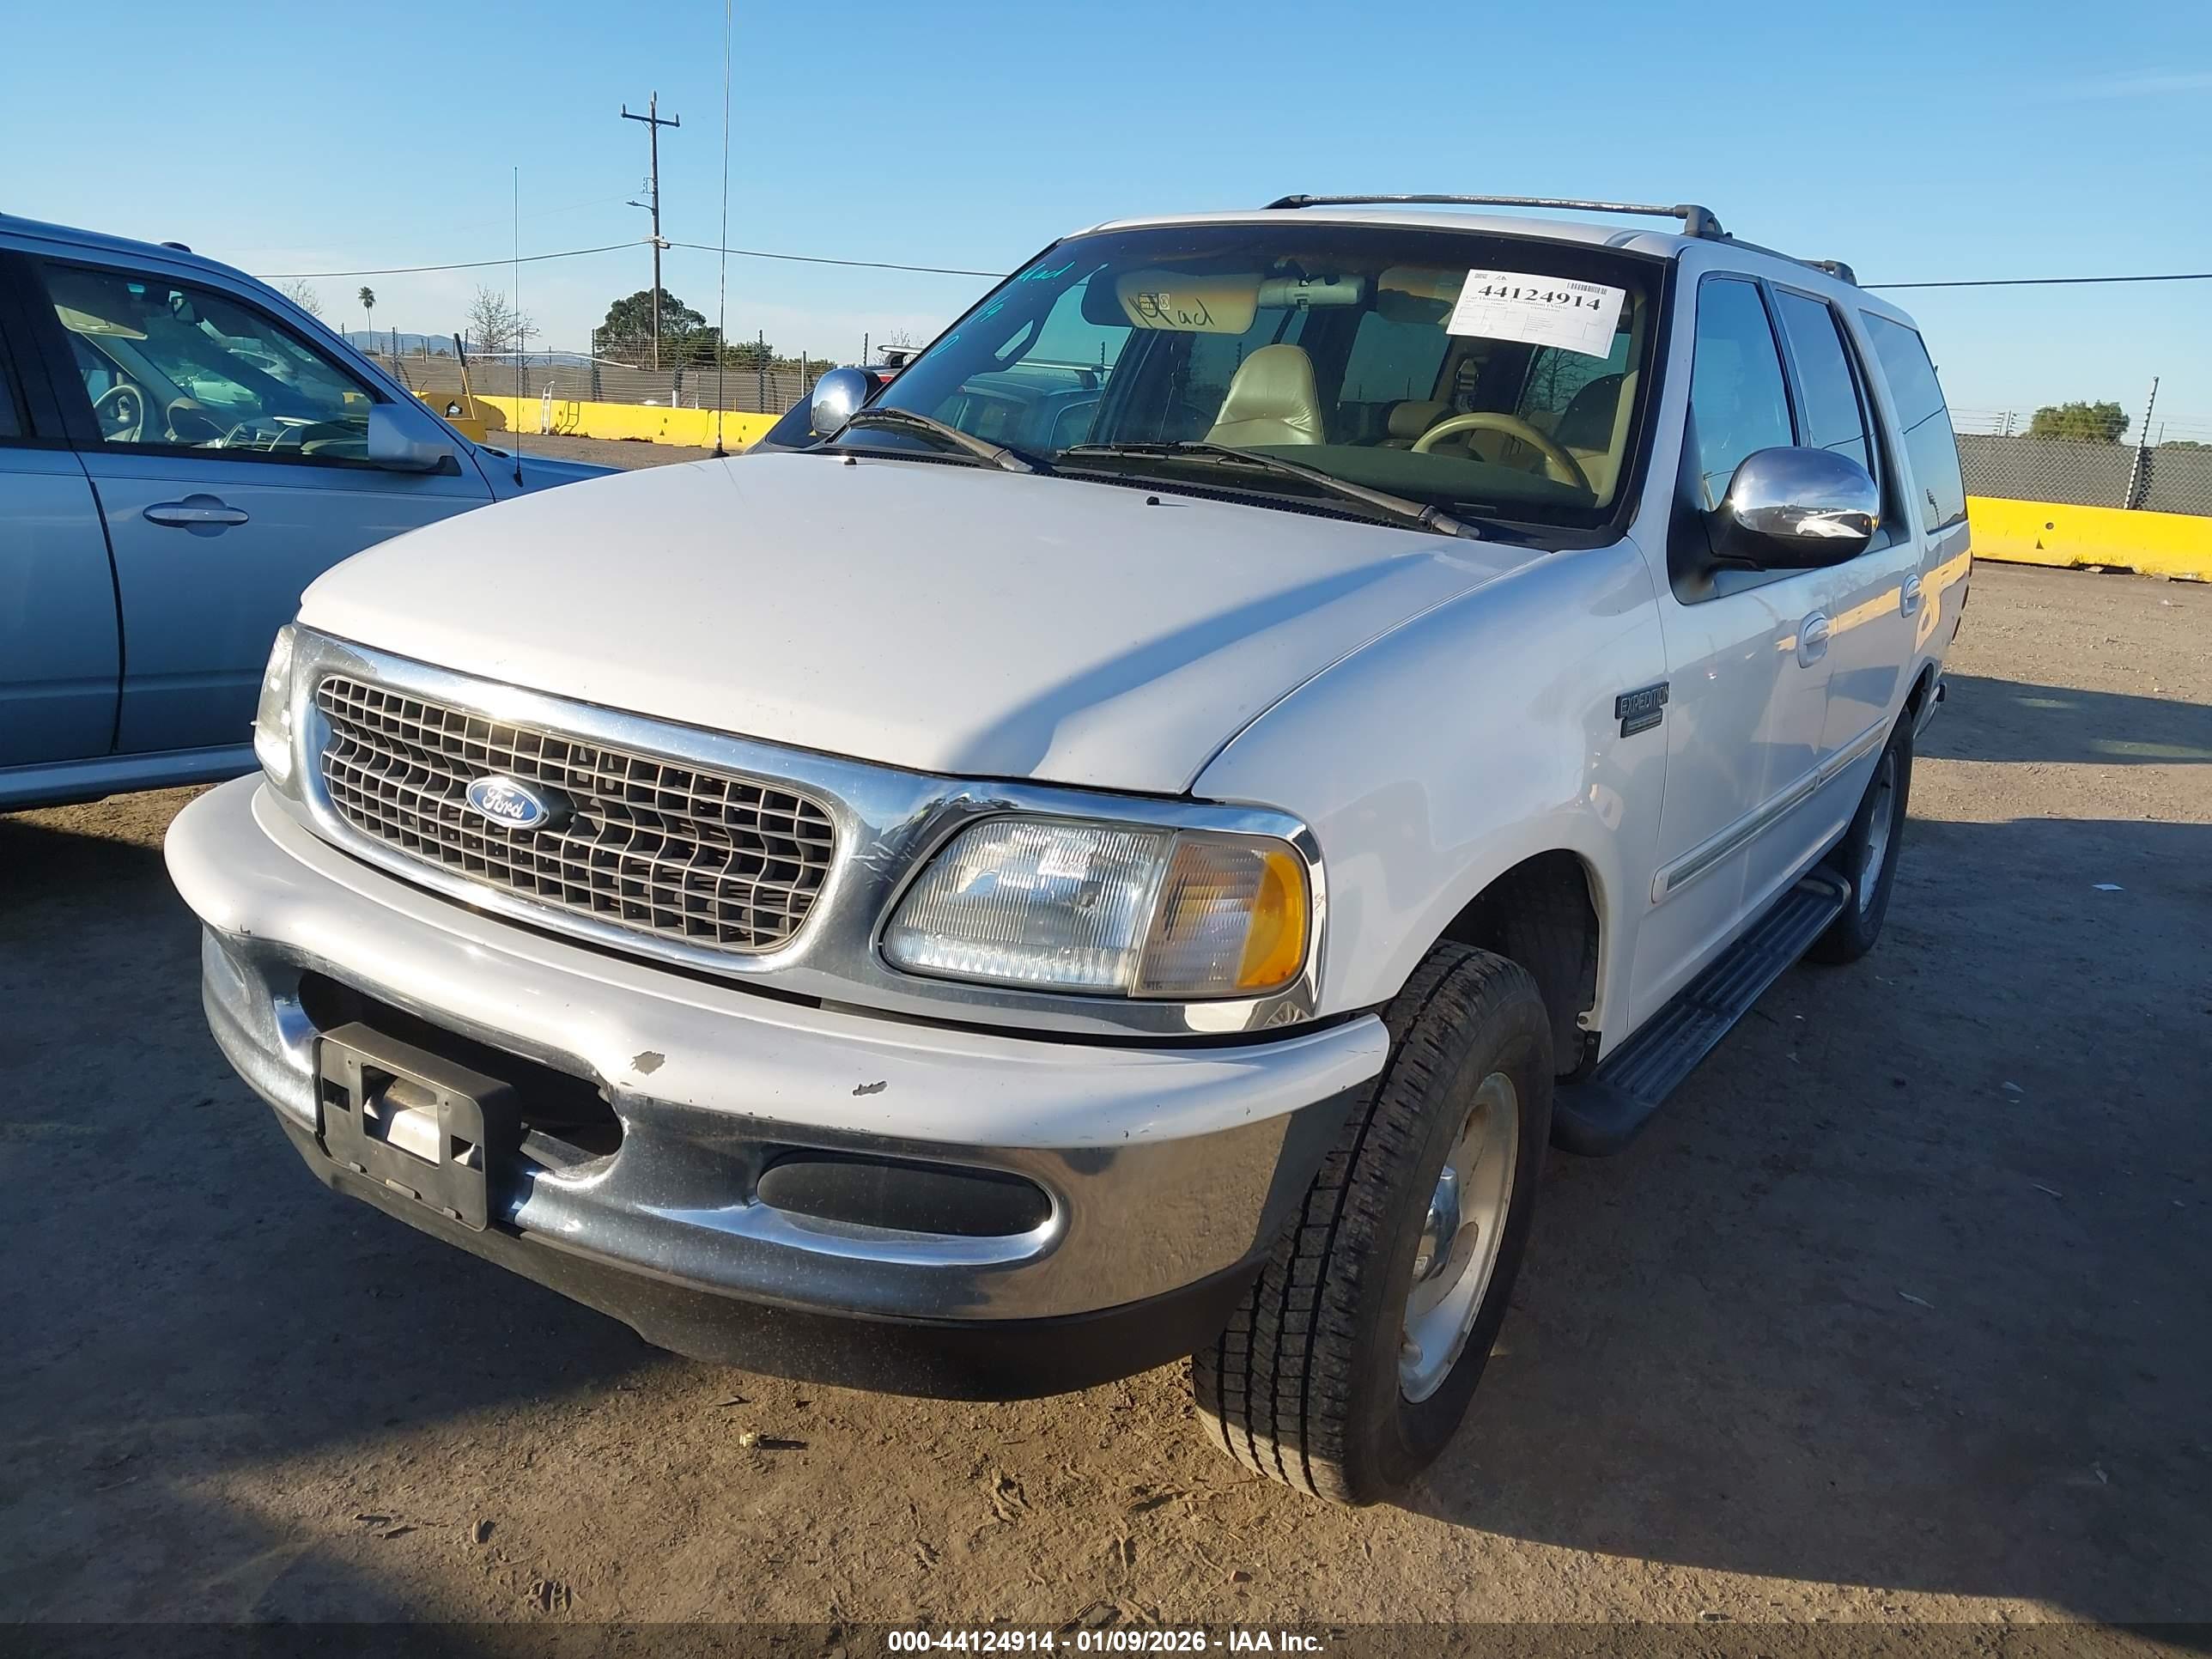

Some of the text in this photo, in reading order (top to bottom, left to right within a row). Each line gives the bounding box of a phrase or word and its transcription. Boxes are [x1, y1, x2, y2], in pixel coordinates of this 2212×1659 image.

[1478, 283, 1601, 311] 44124914
[1620, 685, 1669, 714] EXPEDITION
[482, 785, 525, 818] Ford
